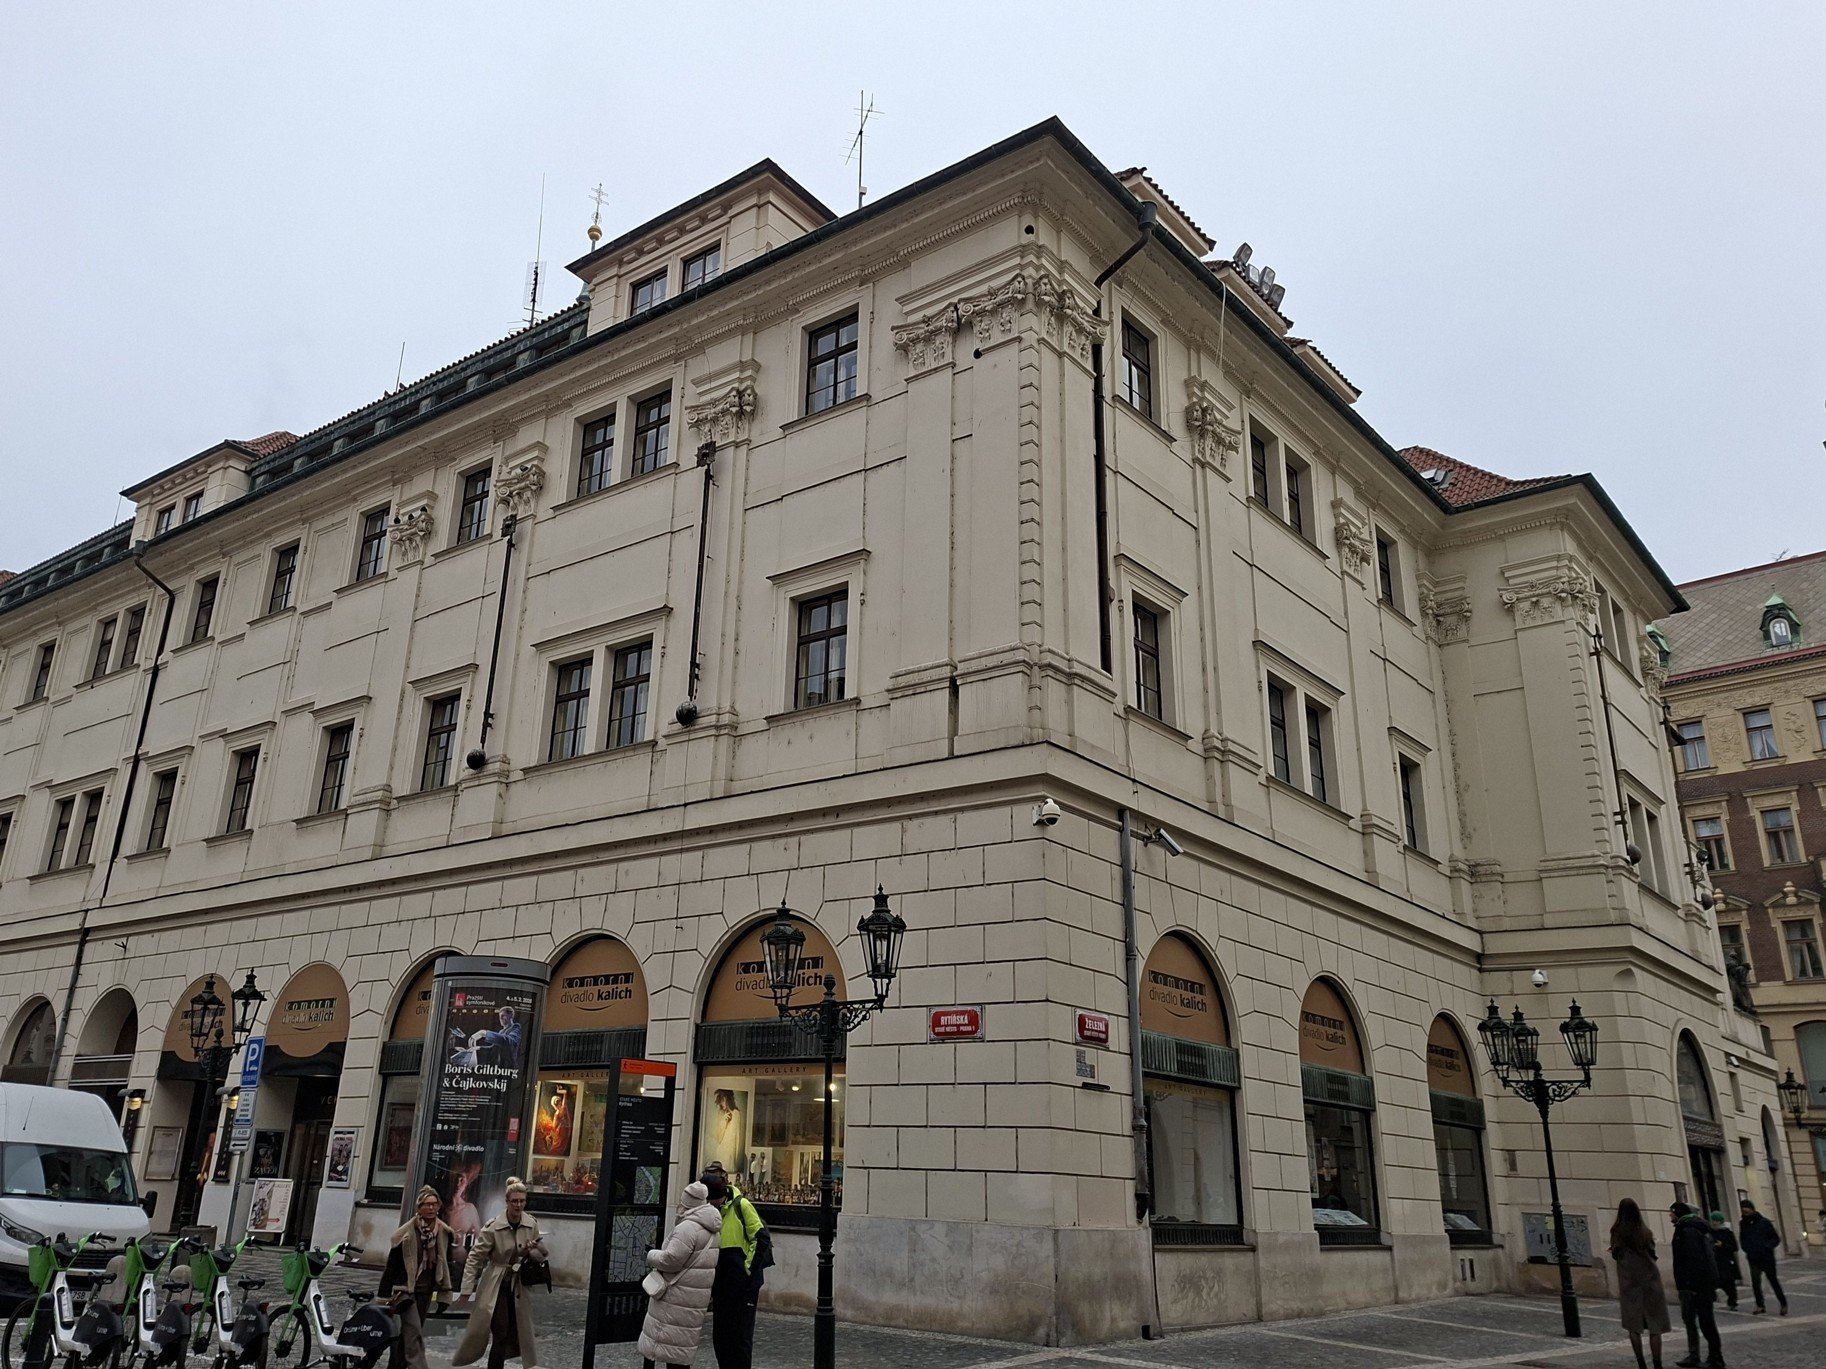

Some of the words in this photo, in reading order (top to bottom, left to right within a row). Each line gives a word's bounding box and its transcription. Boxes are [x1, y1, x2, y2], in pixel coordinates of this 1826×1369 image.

[734, 975, 772, 991] divadl
[560, 990, 594, 1004] divadlo
[596, 986, 633, 1001] kalich
[1149, 986, 1178, 1006] divadlo
[1179, 993, 1207, 1013] kalich
[308, 1009, 335, 1022] kalich
[246, 1043, 260, 1073] P
[445, 1063, 472, 1074] Boris
[474, 1065, 519, 1079] Giltburg
[764, 1065, 807, 1074] GALLERY
[442, 1078, 451, 1088] &
[452, 1075, 507, 1093] Čajkovskij
[463, 1144, 485, 1152] divadlo
